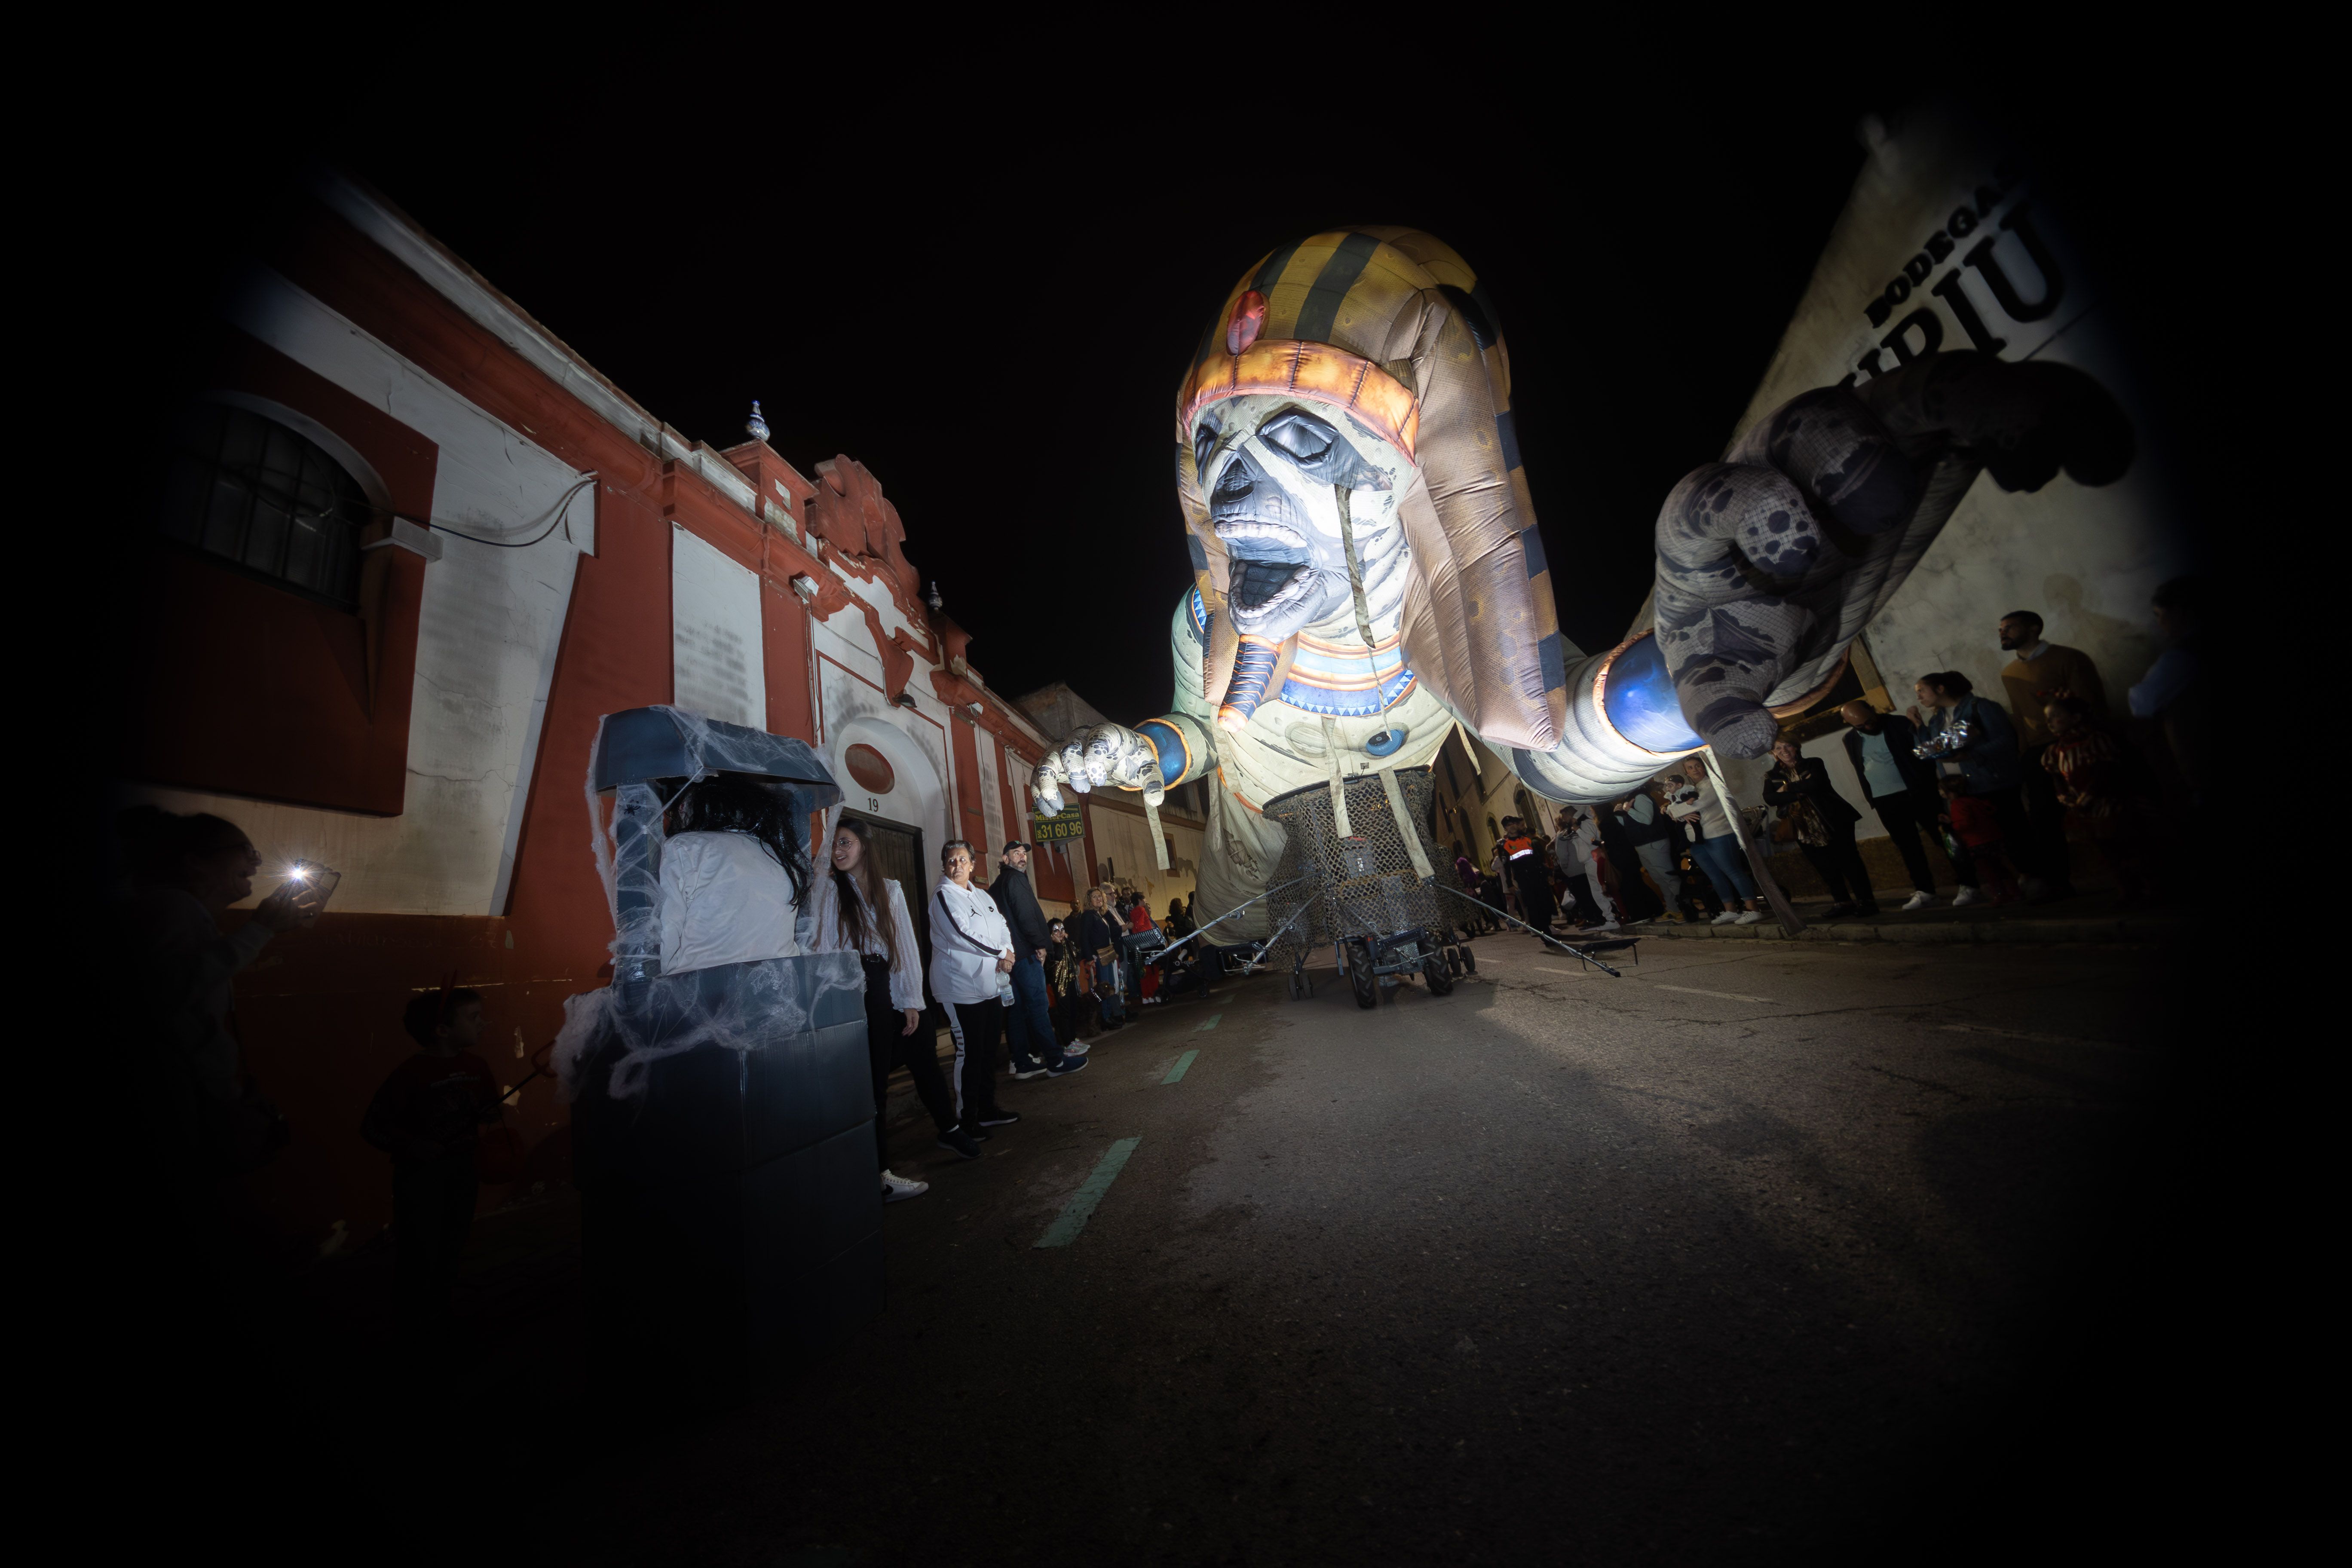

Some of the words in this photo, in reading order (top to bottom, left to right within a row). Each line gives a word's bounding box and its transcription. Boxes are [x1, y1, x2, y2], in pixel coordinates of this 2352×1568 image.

[868, 798, 879, 812] 19
[1041, 824, 1052, 838] 31
[1055, 823, 1067, 837] 60
[1069, 821, 1082, 836] 96
